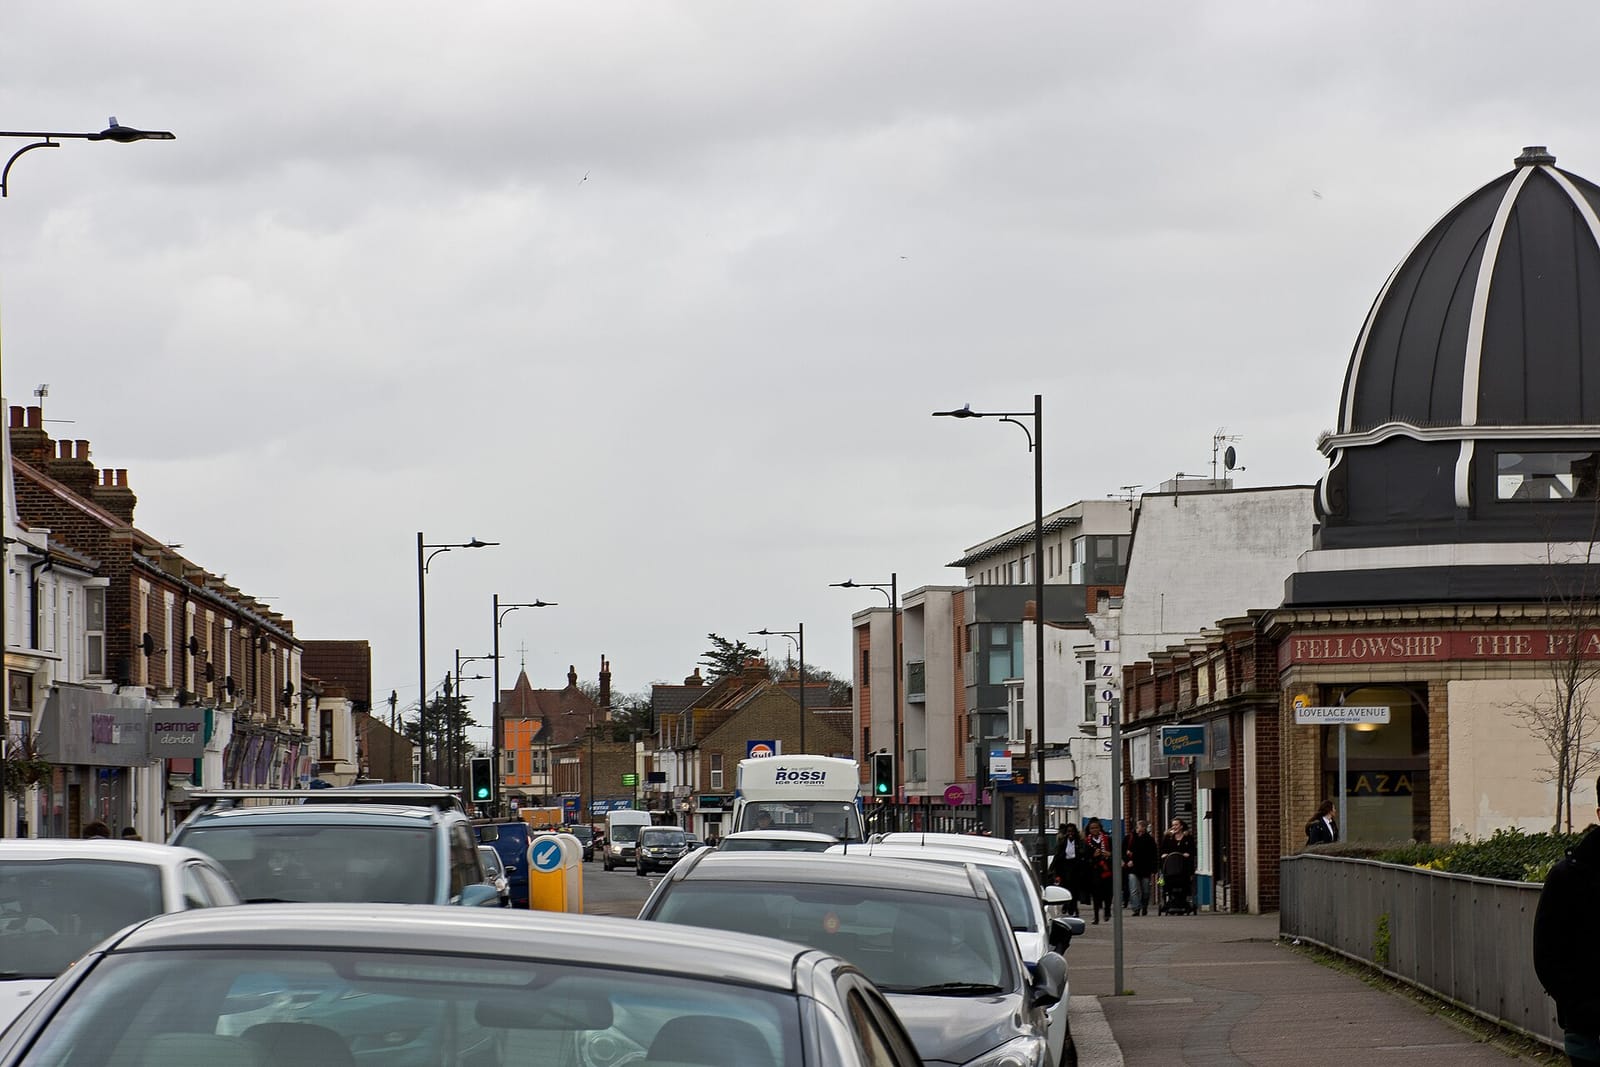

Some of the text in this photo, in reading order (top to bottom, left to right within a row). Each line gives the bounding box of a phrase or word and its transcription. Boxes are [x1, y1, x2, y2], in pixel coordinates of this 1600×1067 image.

[1296, 636, 1442, 659] FELLOWSHIP
[1470, 634, 1532, 655] THE
[1299, 707, 1386, 718] LOVELACE AVENUE
[154, 721, 201, 734] parmar
[160, 733, 195, 744] dental
[751, 751, 772, 759] Gulf
[775, 771, 827, 781] ROSSI
[1344, 773, 1414, 793] AZA
